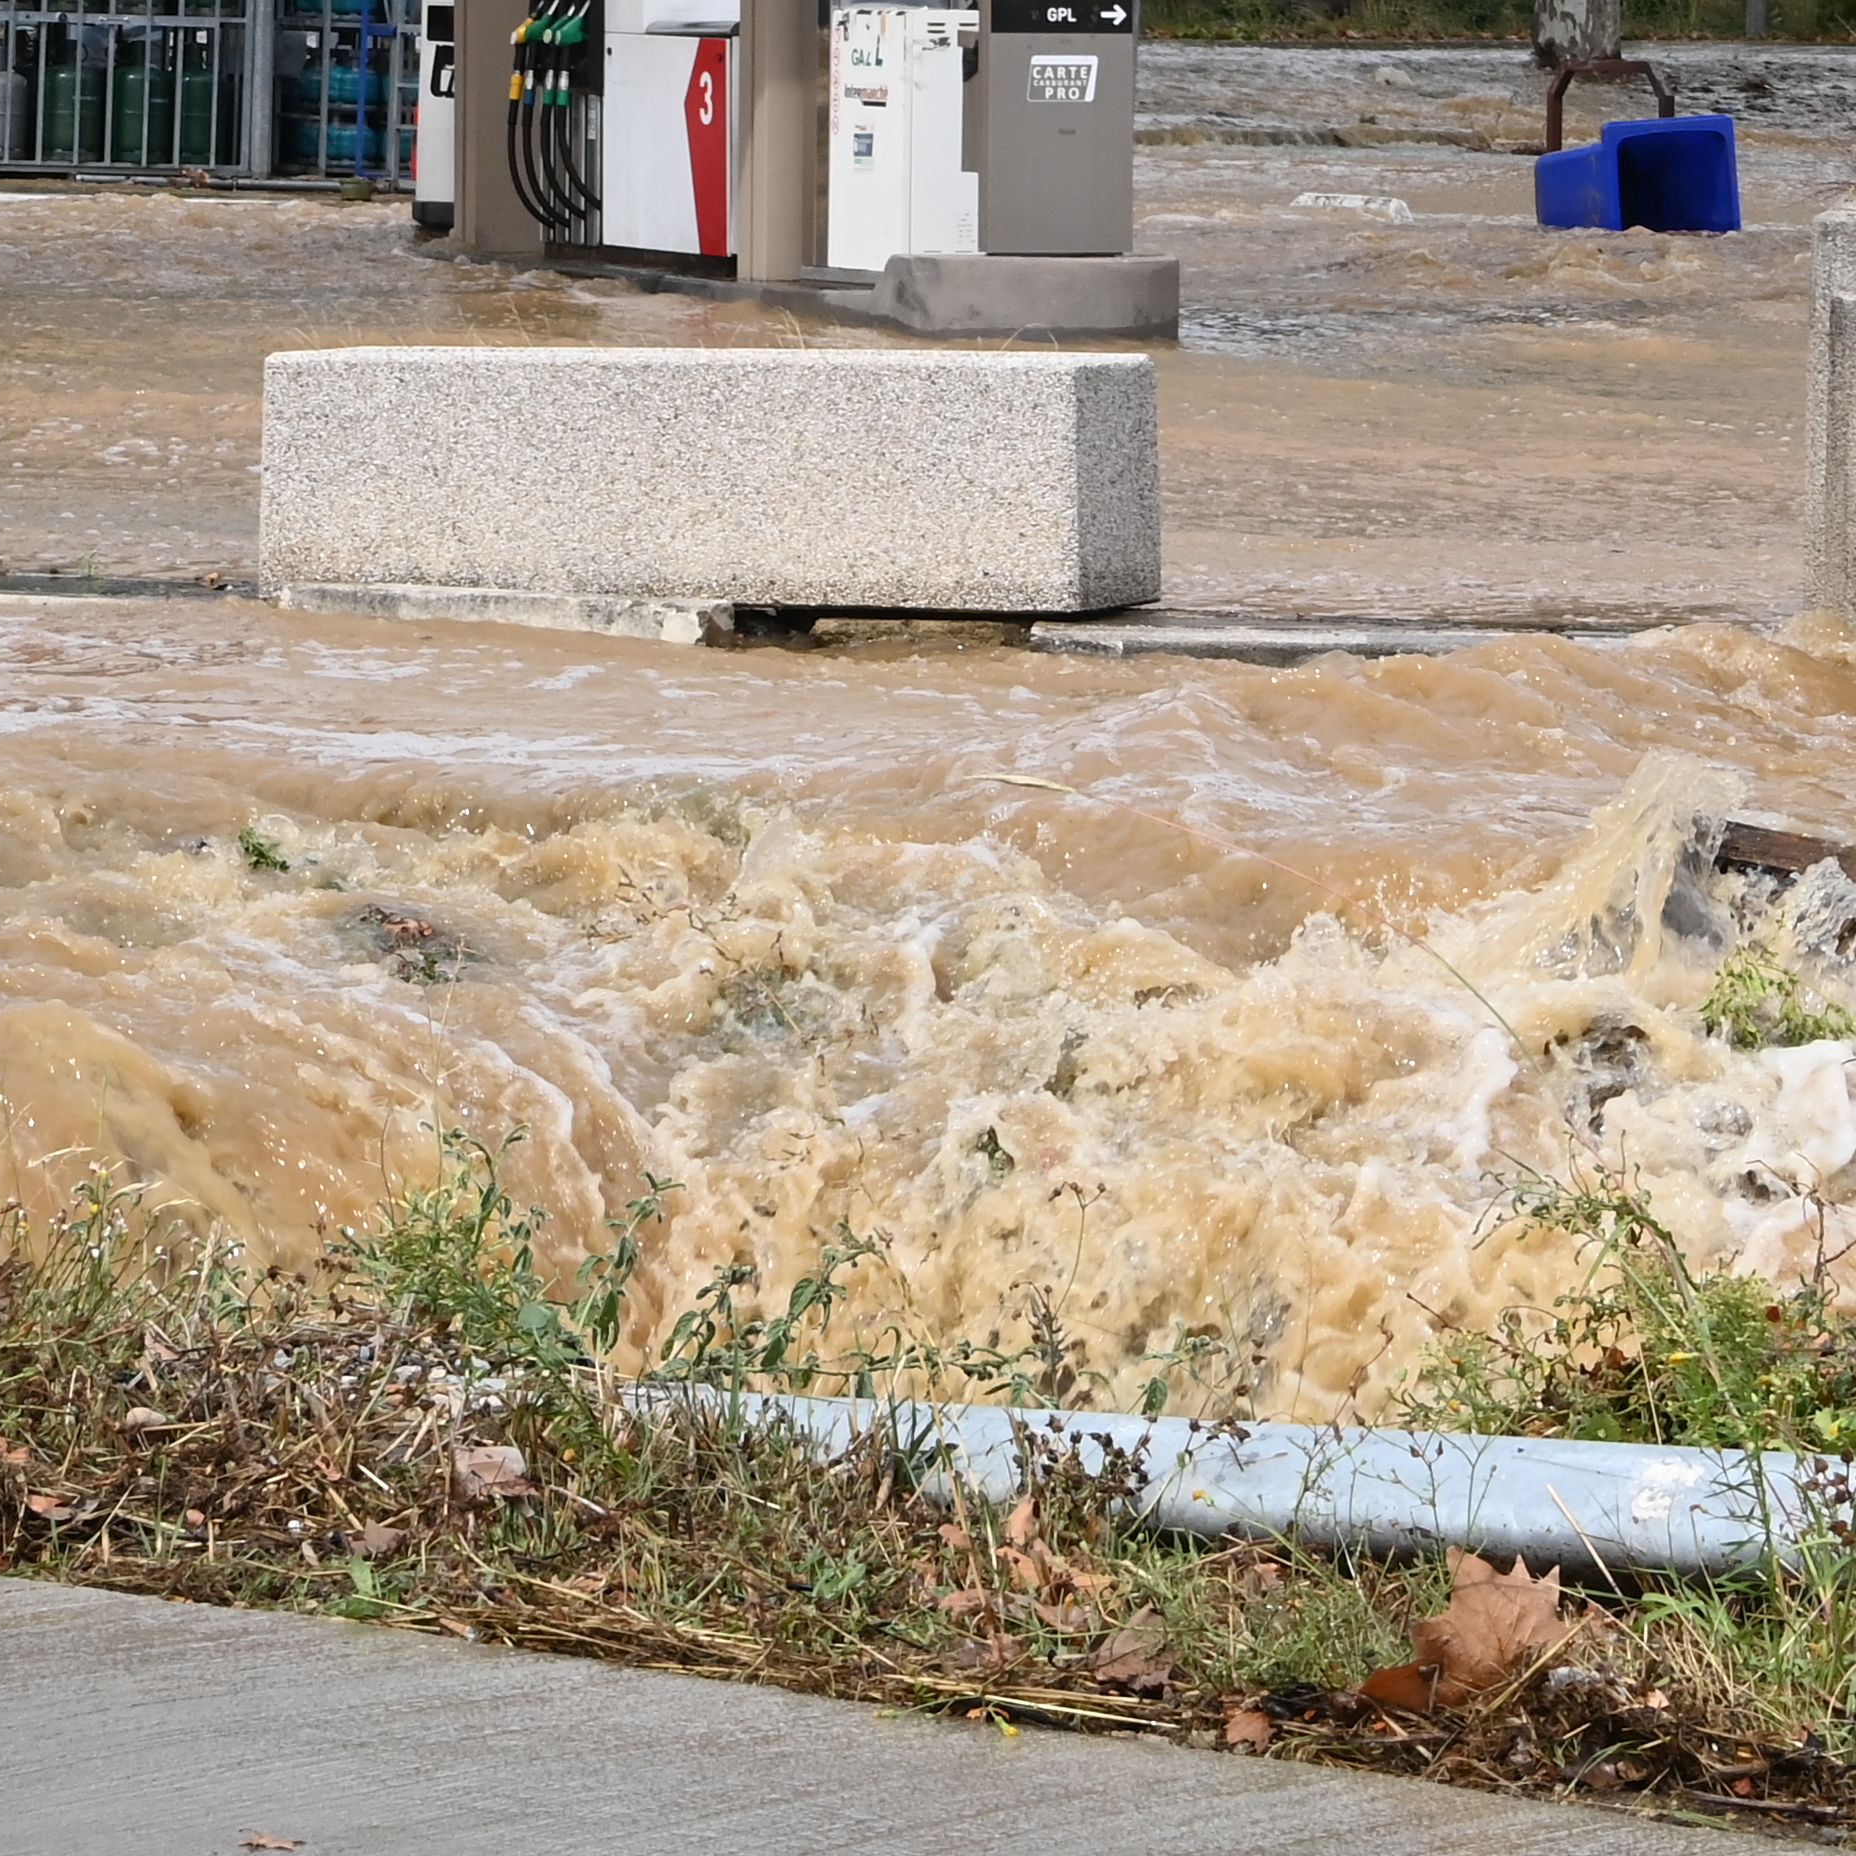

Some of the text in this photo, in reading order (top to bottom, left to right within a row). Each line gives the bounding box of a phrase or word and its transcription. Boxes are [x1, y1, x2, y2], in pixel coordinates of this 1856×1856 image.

[1047, 8, 1077, 22] GPL
[1032, 66, 1089, 79] CARTE
[1033, 79, 1087, 87] CARBURANT
[699, 71, 713, 125] 3
[1045, 87, 1080, 100] PRO
